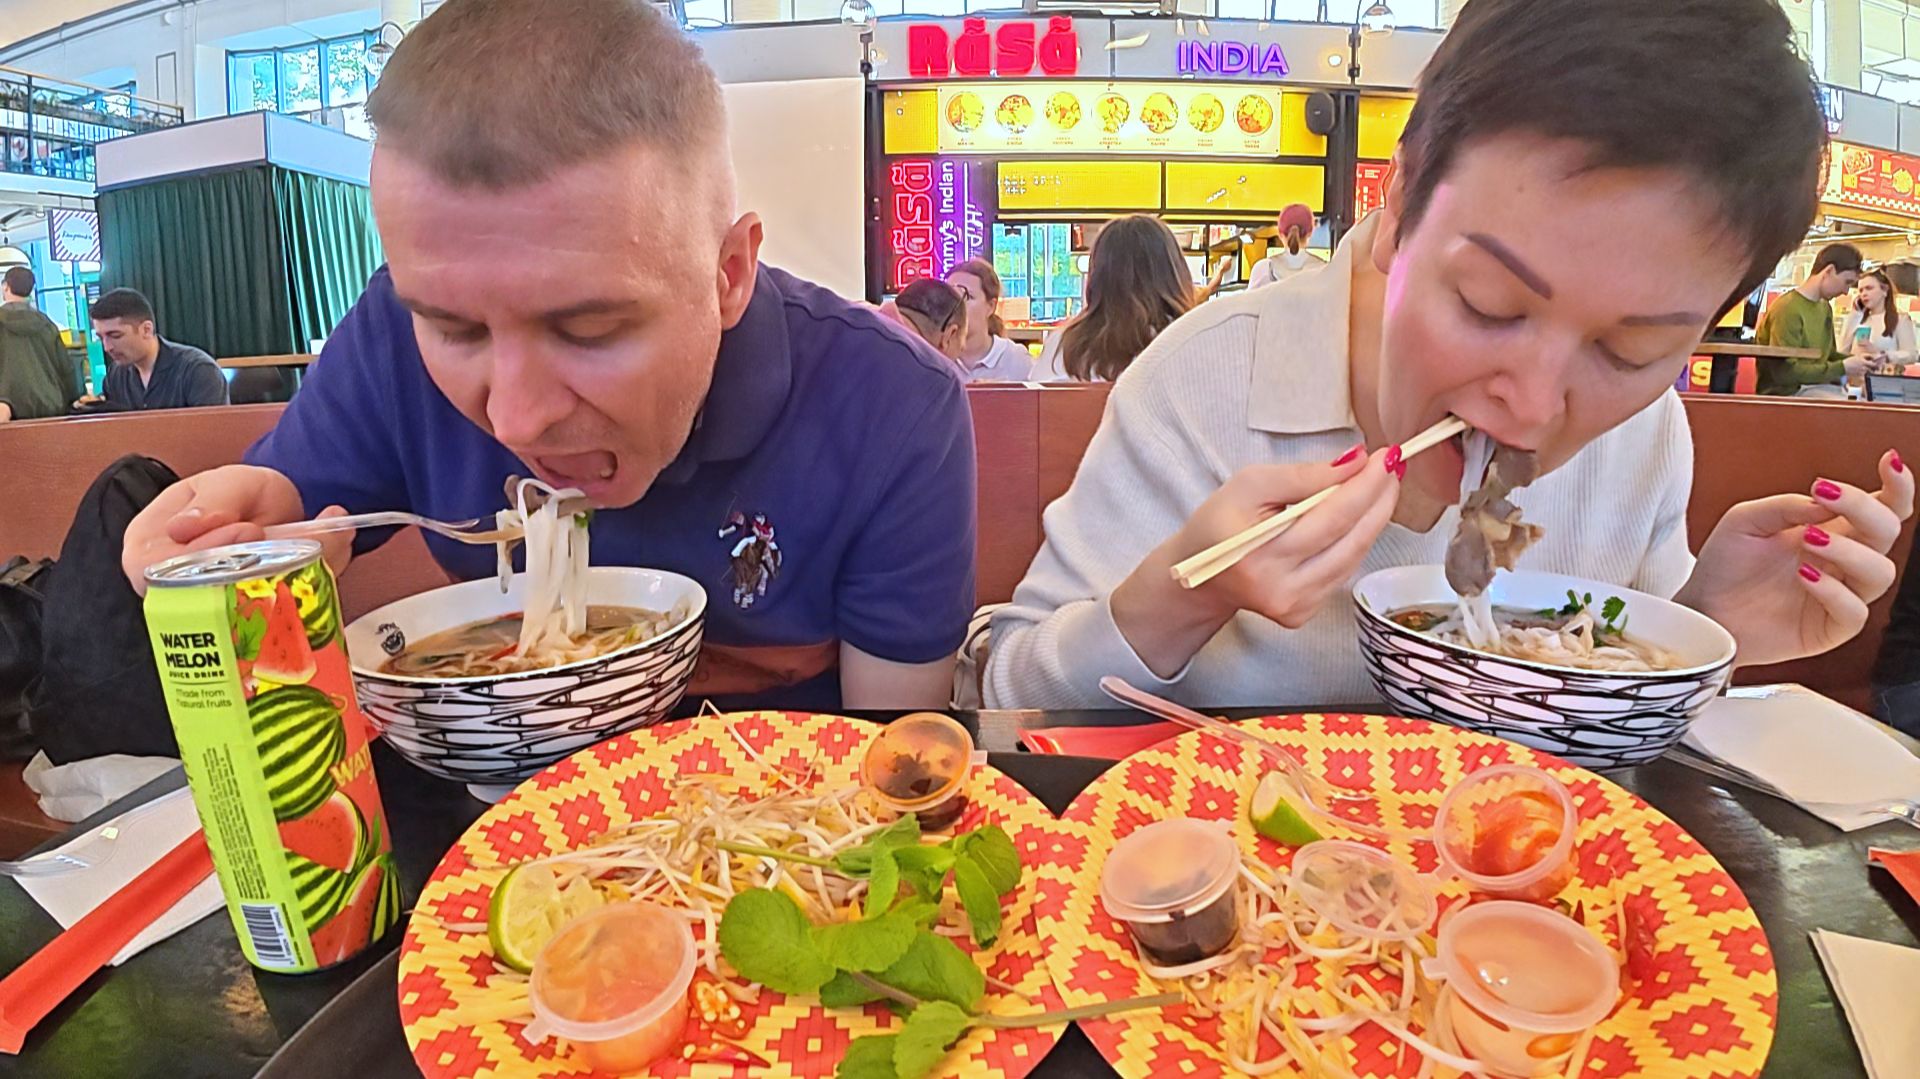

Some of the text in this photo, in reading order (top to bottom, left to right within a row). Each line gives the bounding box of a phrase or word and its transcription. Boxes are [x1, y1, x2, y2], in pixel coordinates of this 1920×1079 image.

[1179, 40, 1289, 75] INDIA
[938, 162, 957, 282] mmy's Indian
[160, 632, 217, 649] WATER
[165, 651, 222, 668] MELON
[194, 670, 225, 678] DRINK
[201, 689, 225, 698] from
[206, 699, 232, 709] fruits
